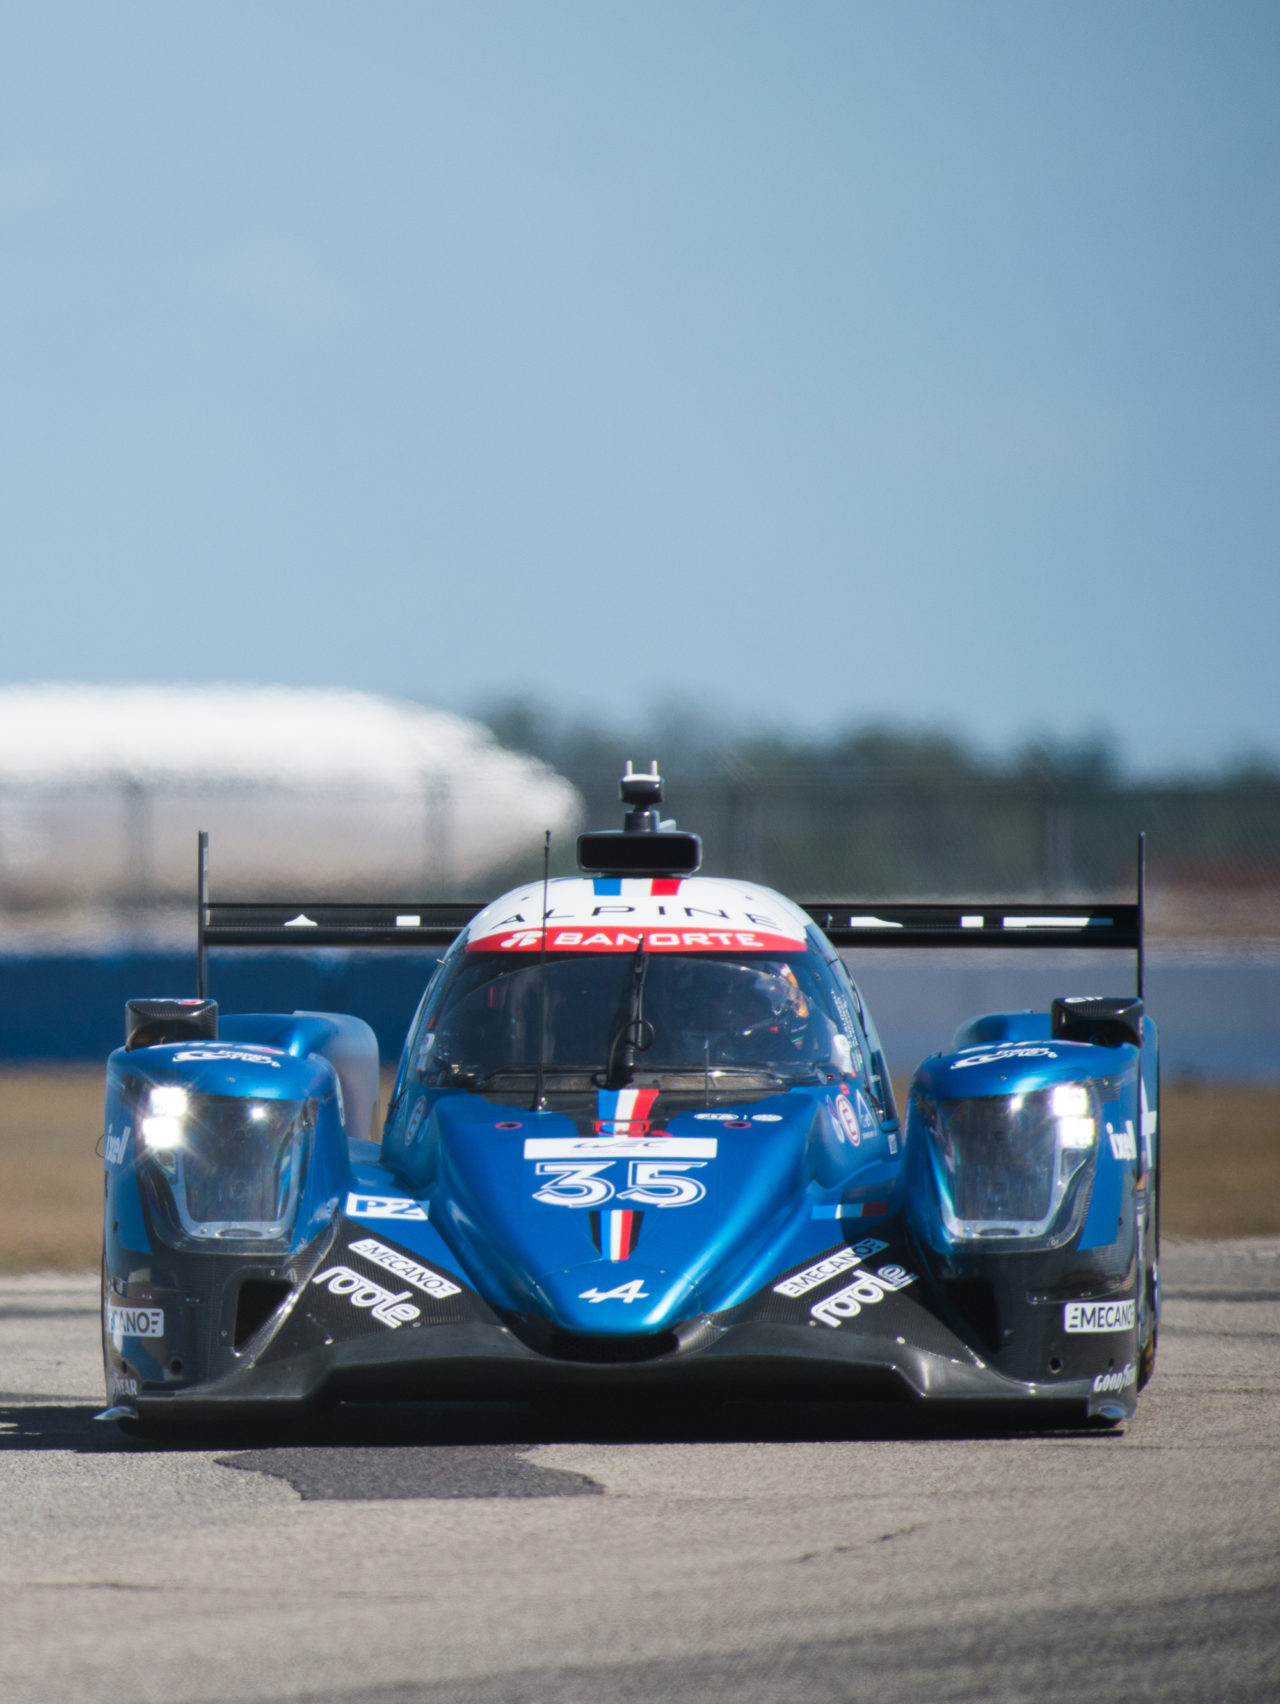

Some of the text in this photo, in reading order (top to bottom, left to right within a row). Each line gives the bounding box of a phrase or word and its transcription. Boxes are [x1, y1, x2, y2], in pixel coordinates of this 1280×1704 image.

[490, 904, 783, 931] ALPINE
[553, 932, 765, 947] BANORTE
[531, 1160, 707, 1209] 35
[355, 1199, 423, 1216] P2
